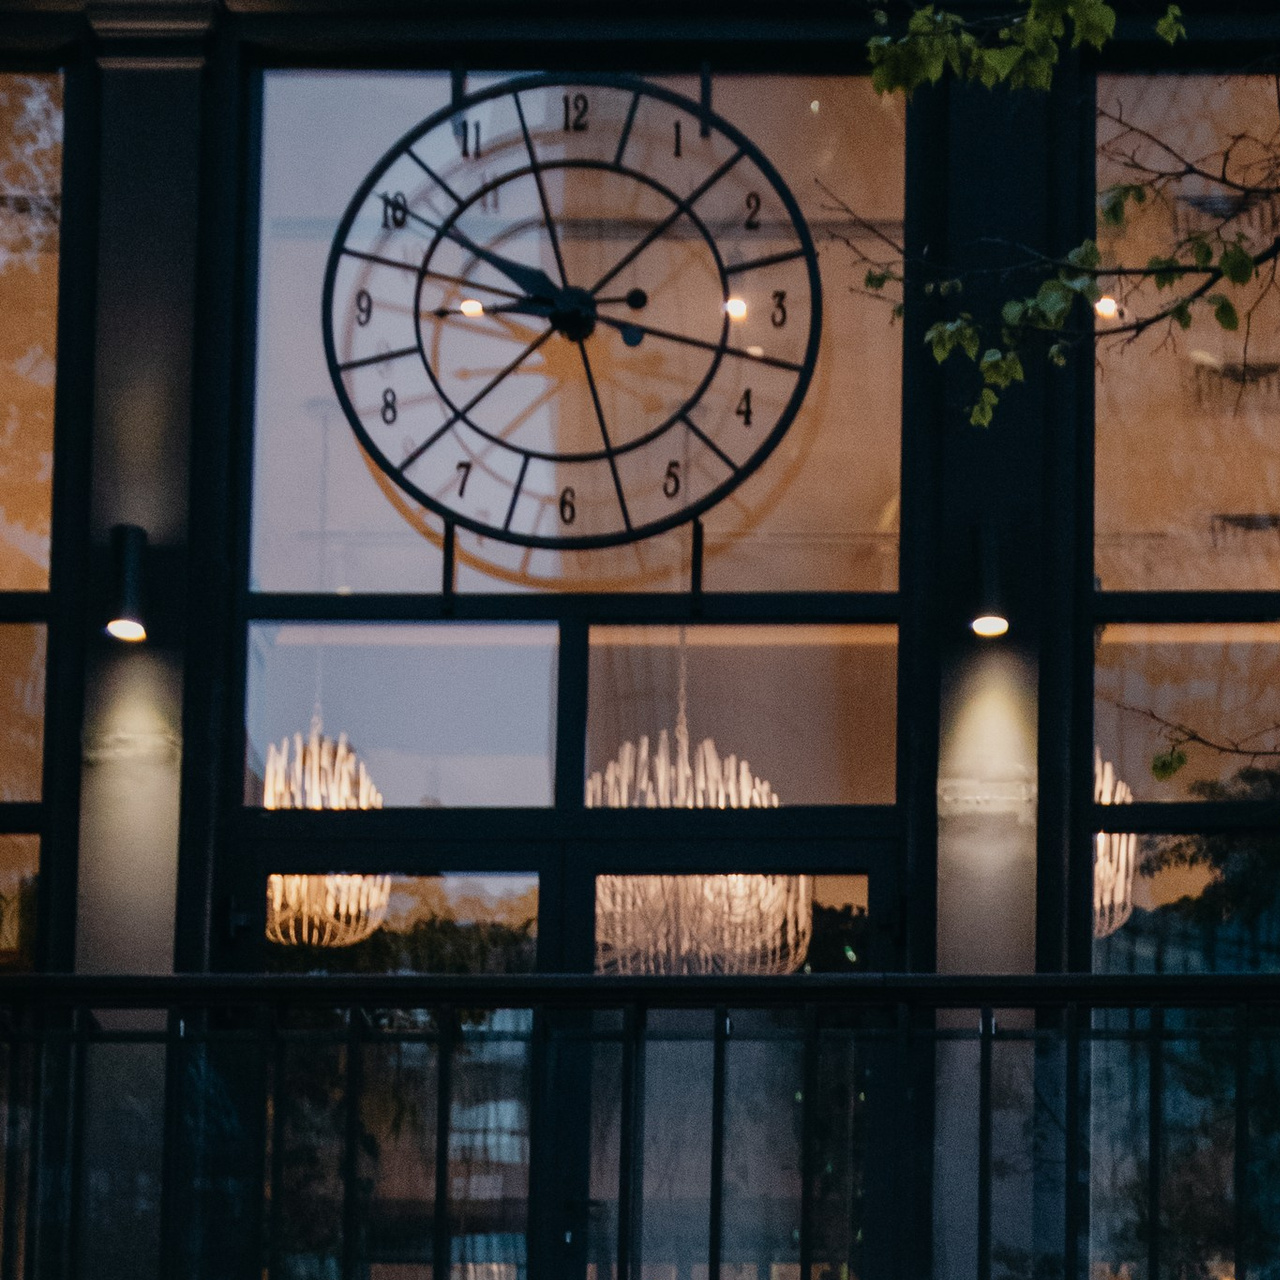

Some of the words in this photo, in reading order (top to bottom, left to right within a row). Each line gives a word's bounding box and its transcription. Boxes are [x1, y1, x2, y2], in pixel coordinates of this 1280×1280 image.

[562, 94, 589, 132] 12
[461, 120, 482, 159] 11
[673, 121, 683, 158] 1
[745, 193, 762, 230] 2
[357, 290, 373, 326] 9
[771, 290, 787, 327] 3
[381, 388, 397, 424] 8
[736, 388, 753, 427] 4
[456, 462, 472, 498] 7
[663, 461, 681, 498] 5
[560, 487, 576, 525] 6
